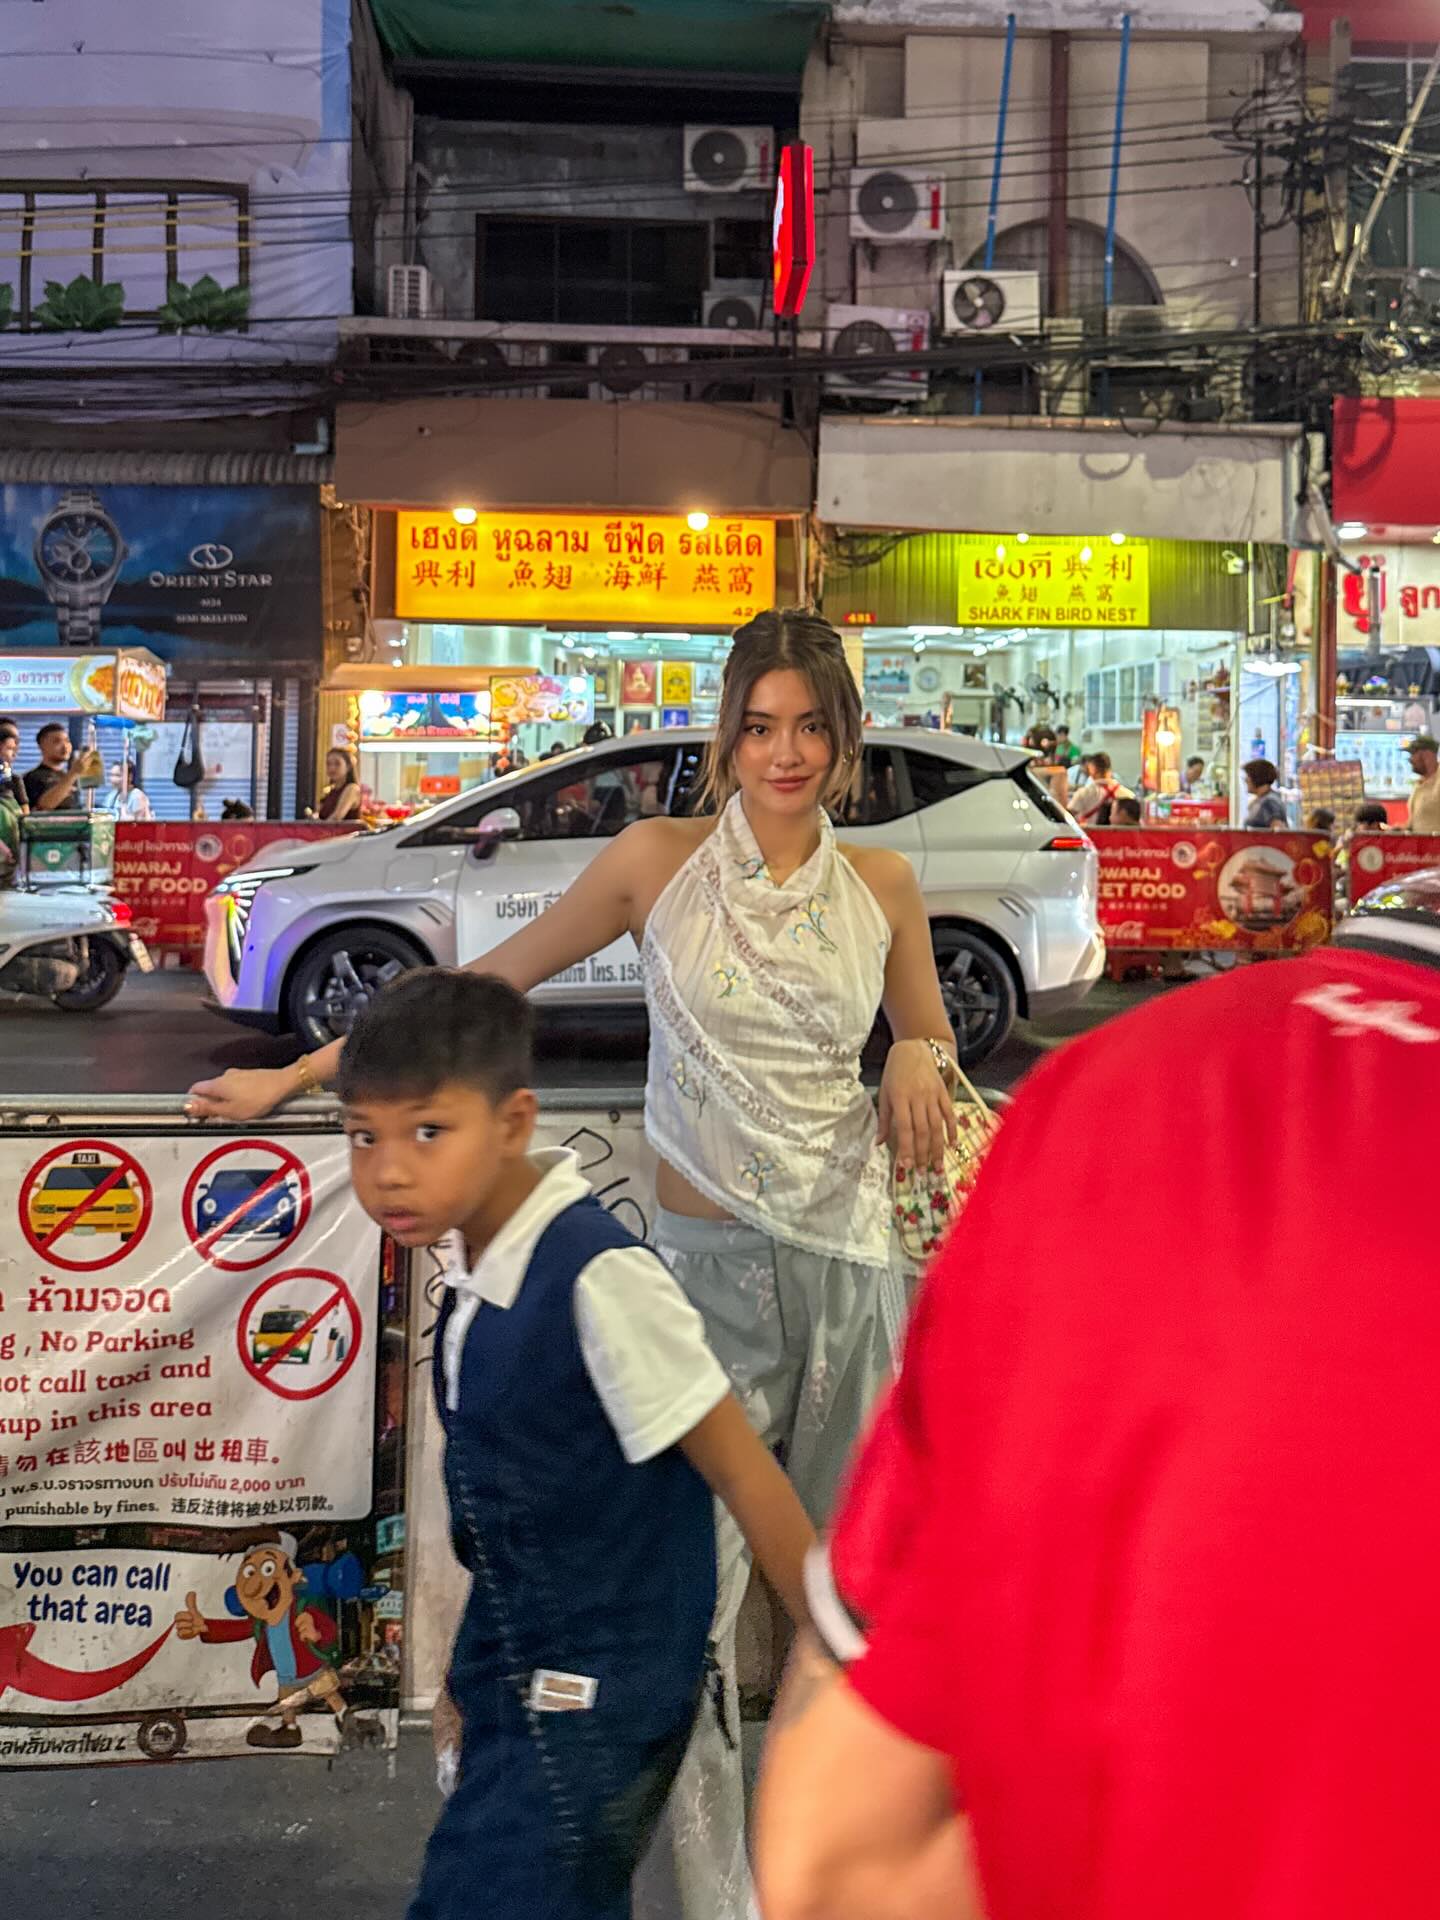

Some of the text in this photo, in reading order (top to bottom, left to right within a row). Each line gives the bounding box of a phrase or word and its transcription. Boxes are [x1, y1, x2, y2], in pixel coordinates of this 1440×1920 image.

[493, 528, 590, 562] หูฉลาม
[150, 569, 273, 588] ORIENT STAR
[412, 559, 755, 595] 興利 魚翅 海鮮 燕窩
[968, 605, 1137, 622] SHARK FIN BIRD NEST
[147, 877, 208, 894] FOOD
[1131, 882, 1186, 899] FOOD
[28, 1276, 172, 1313] ห้ามจอด
[40, 1331, 77, 1352] No
[85, 1328, 195, 1353] Parking
[0, 1355, 211, 1393] ot call taxi and
[51, 1409, 78, 1431] in
[88, 1398, 140, 1423] this
[150, 1401, 212, 1417] area
[230, 1478, 271, 1494] 2,000
[5, 1500, 89, 1520] punishable
[94, 1500, 112, 1518] by
[117, 1499, 160, 1513] fines.
[72, 1563, 118, 1587] can
[126, 1561, 171, 1592] call
[27, 1592, 153, 1628] that area
